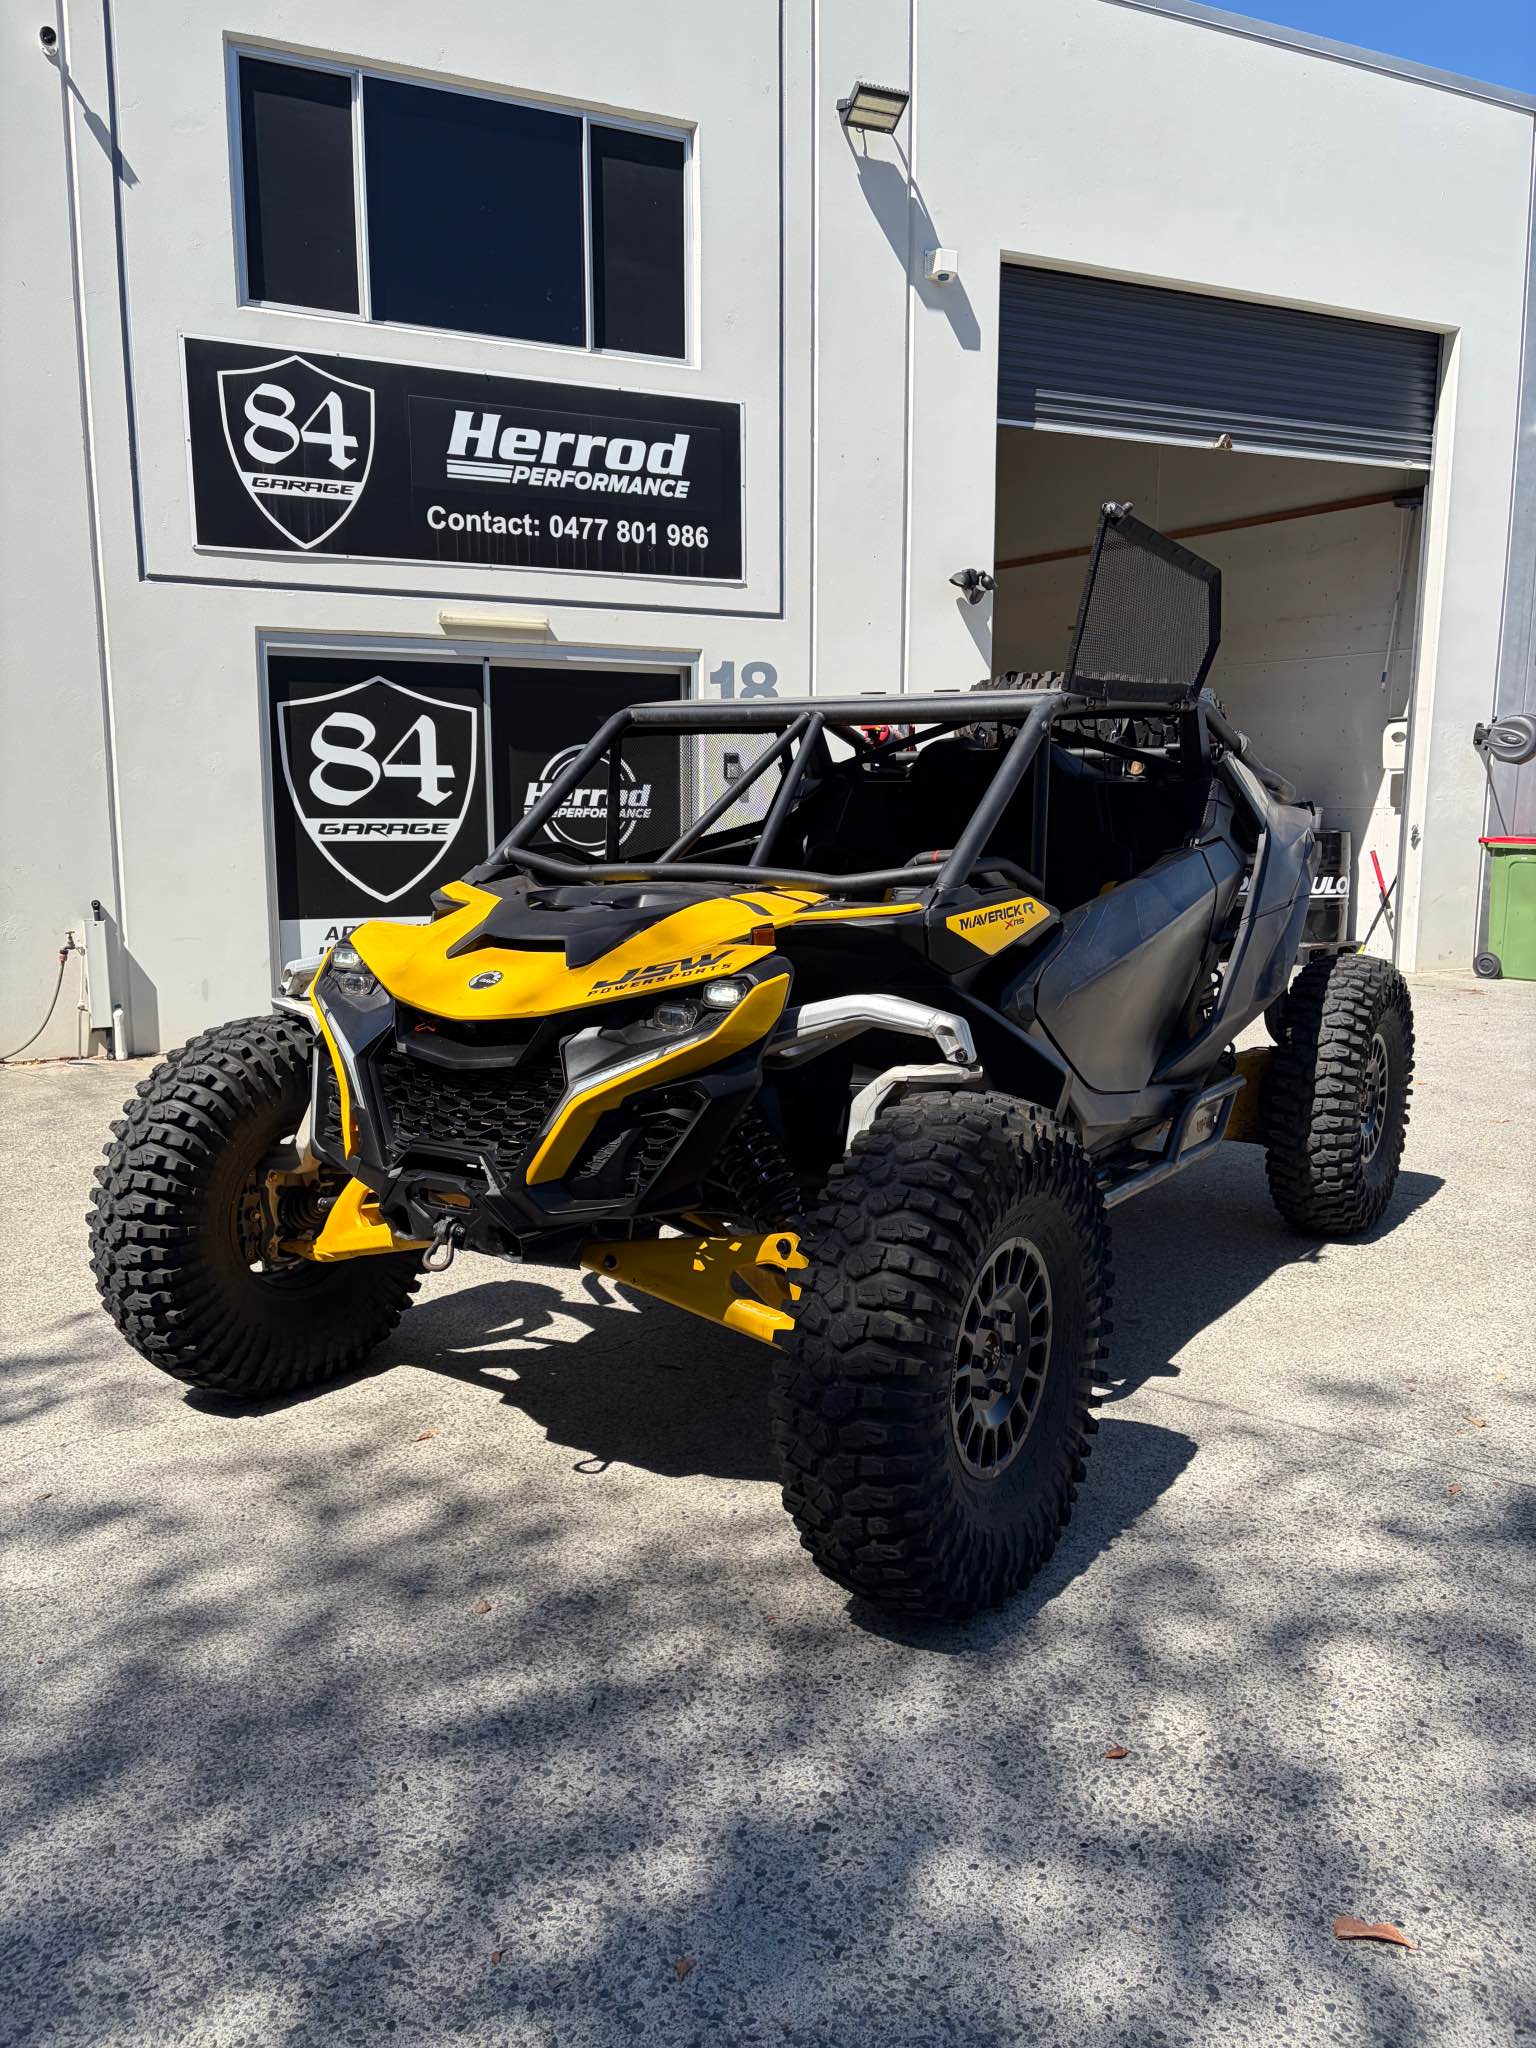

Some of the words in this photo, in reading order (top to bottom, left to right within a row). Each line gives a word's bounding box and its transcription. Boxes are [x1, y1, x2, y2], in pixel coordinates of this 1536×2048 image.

[244, 383, 358, 470] 84
[446, 409, 690, 476] Herrod
[251, 477, 355, 495] GARAGE
[511, 465, 691, 499] PERFORMANCE
[426, 505, 540, 537] Contact:
[549, 514, 608, 541] 0477
[616, 520, 657, 545] 801
[666, 524, 709, 549] 986
[709, 661, 779, 698] 18
[309, 711, 456, 807] 84
[318, 823, 451, 838] GARAGE
[557, 807, 652, 819] PERFORANCE
[959, 904, 1022, 931] MAVERICK
[586, 962, 733, 998] POWERSPORTS
[591, 949, 737, 990] JSW
